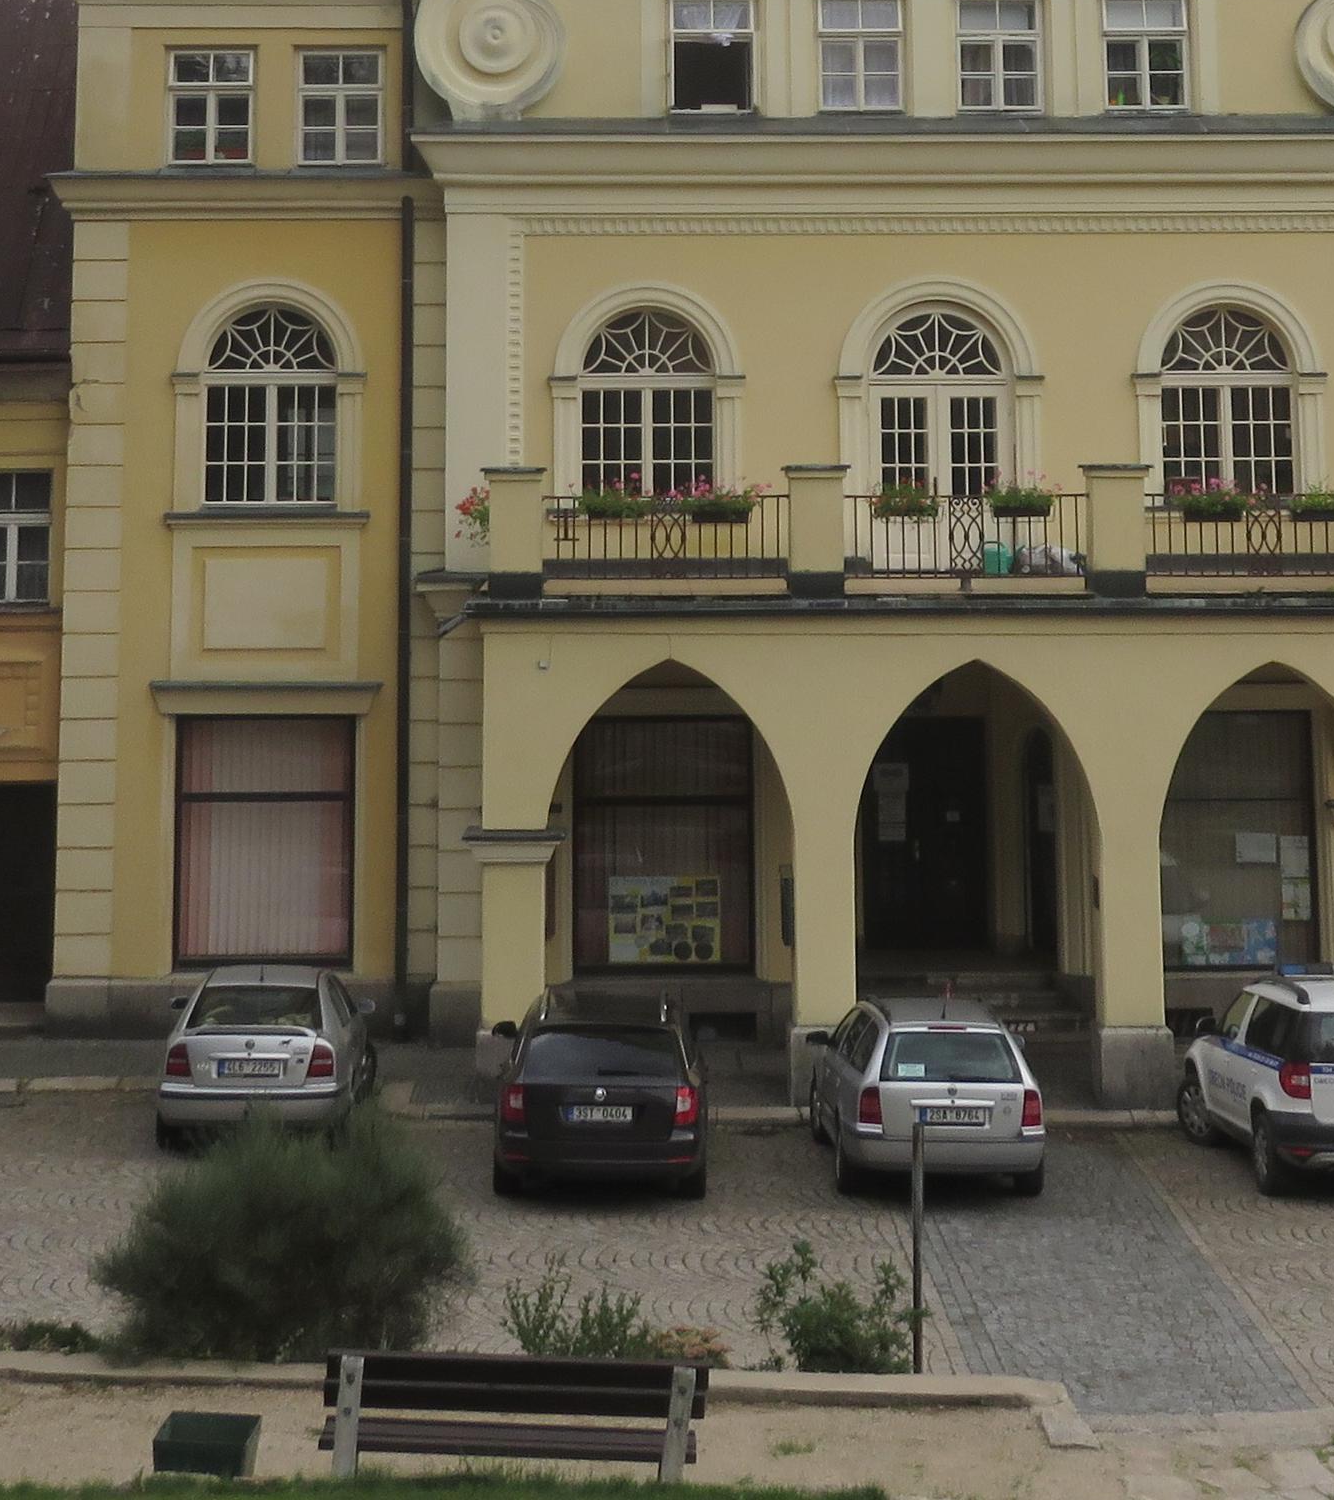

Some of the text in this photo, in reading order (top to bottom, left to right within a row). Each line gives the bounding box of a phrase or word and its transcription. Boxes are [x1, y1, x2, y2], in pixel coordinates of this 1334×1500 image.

[576, 1107, 628, 1119] 3ST 0404
[929, 1108, 947, 1120] 2SA
